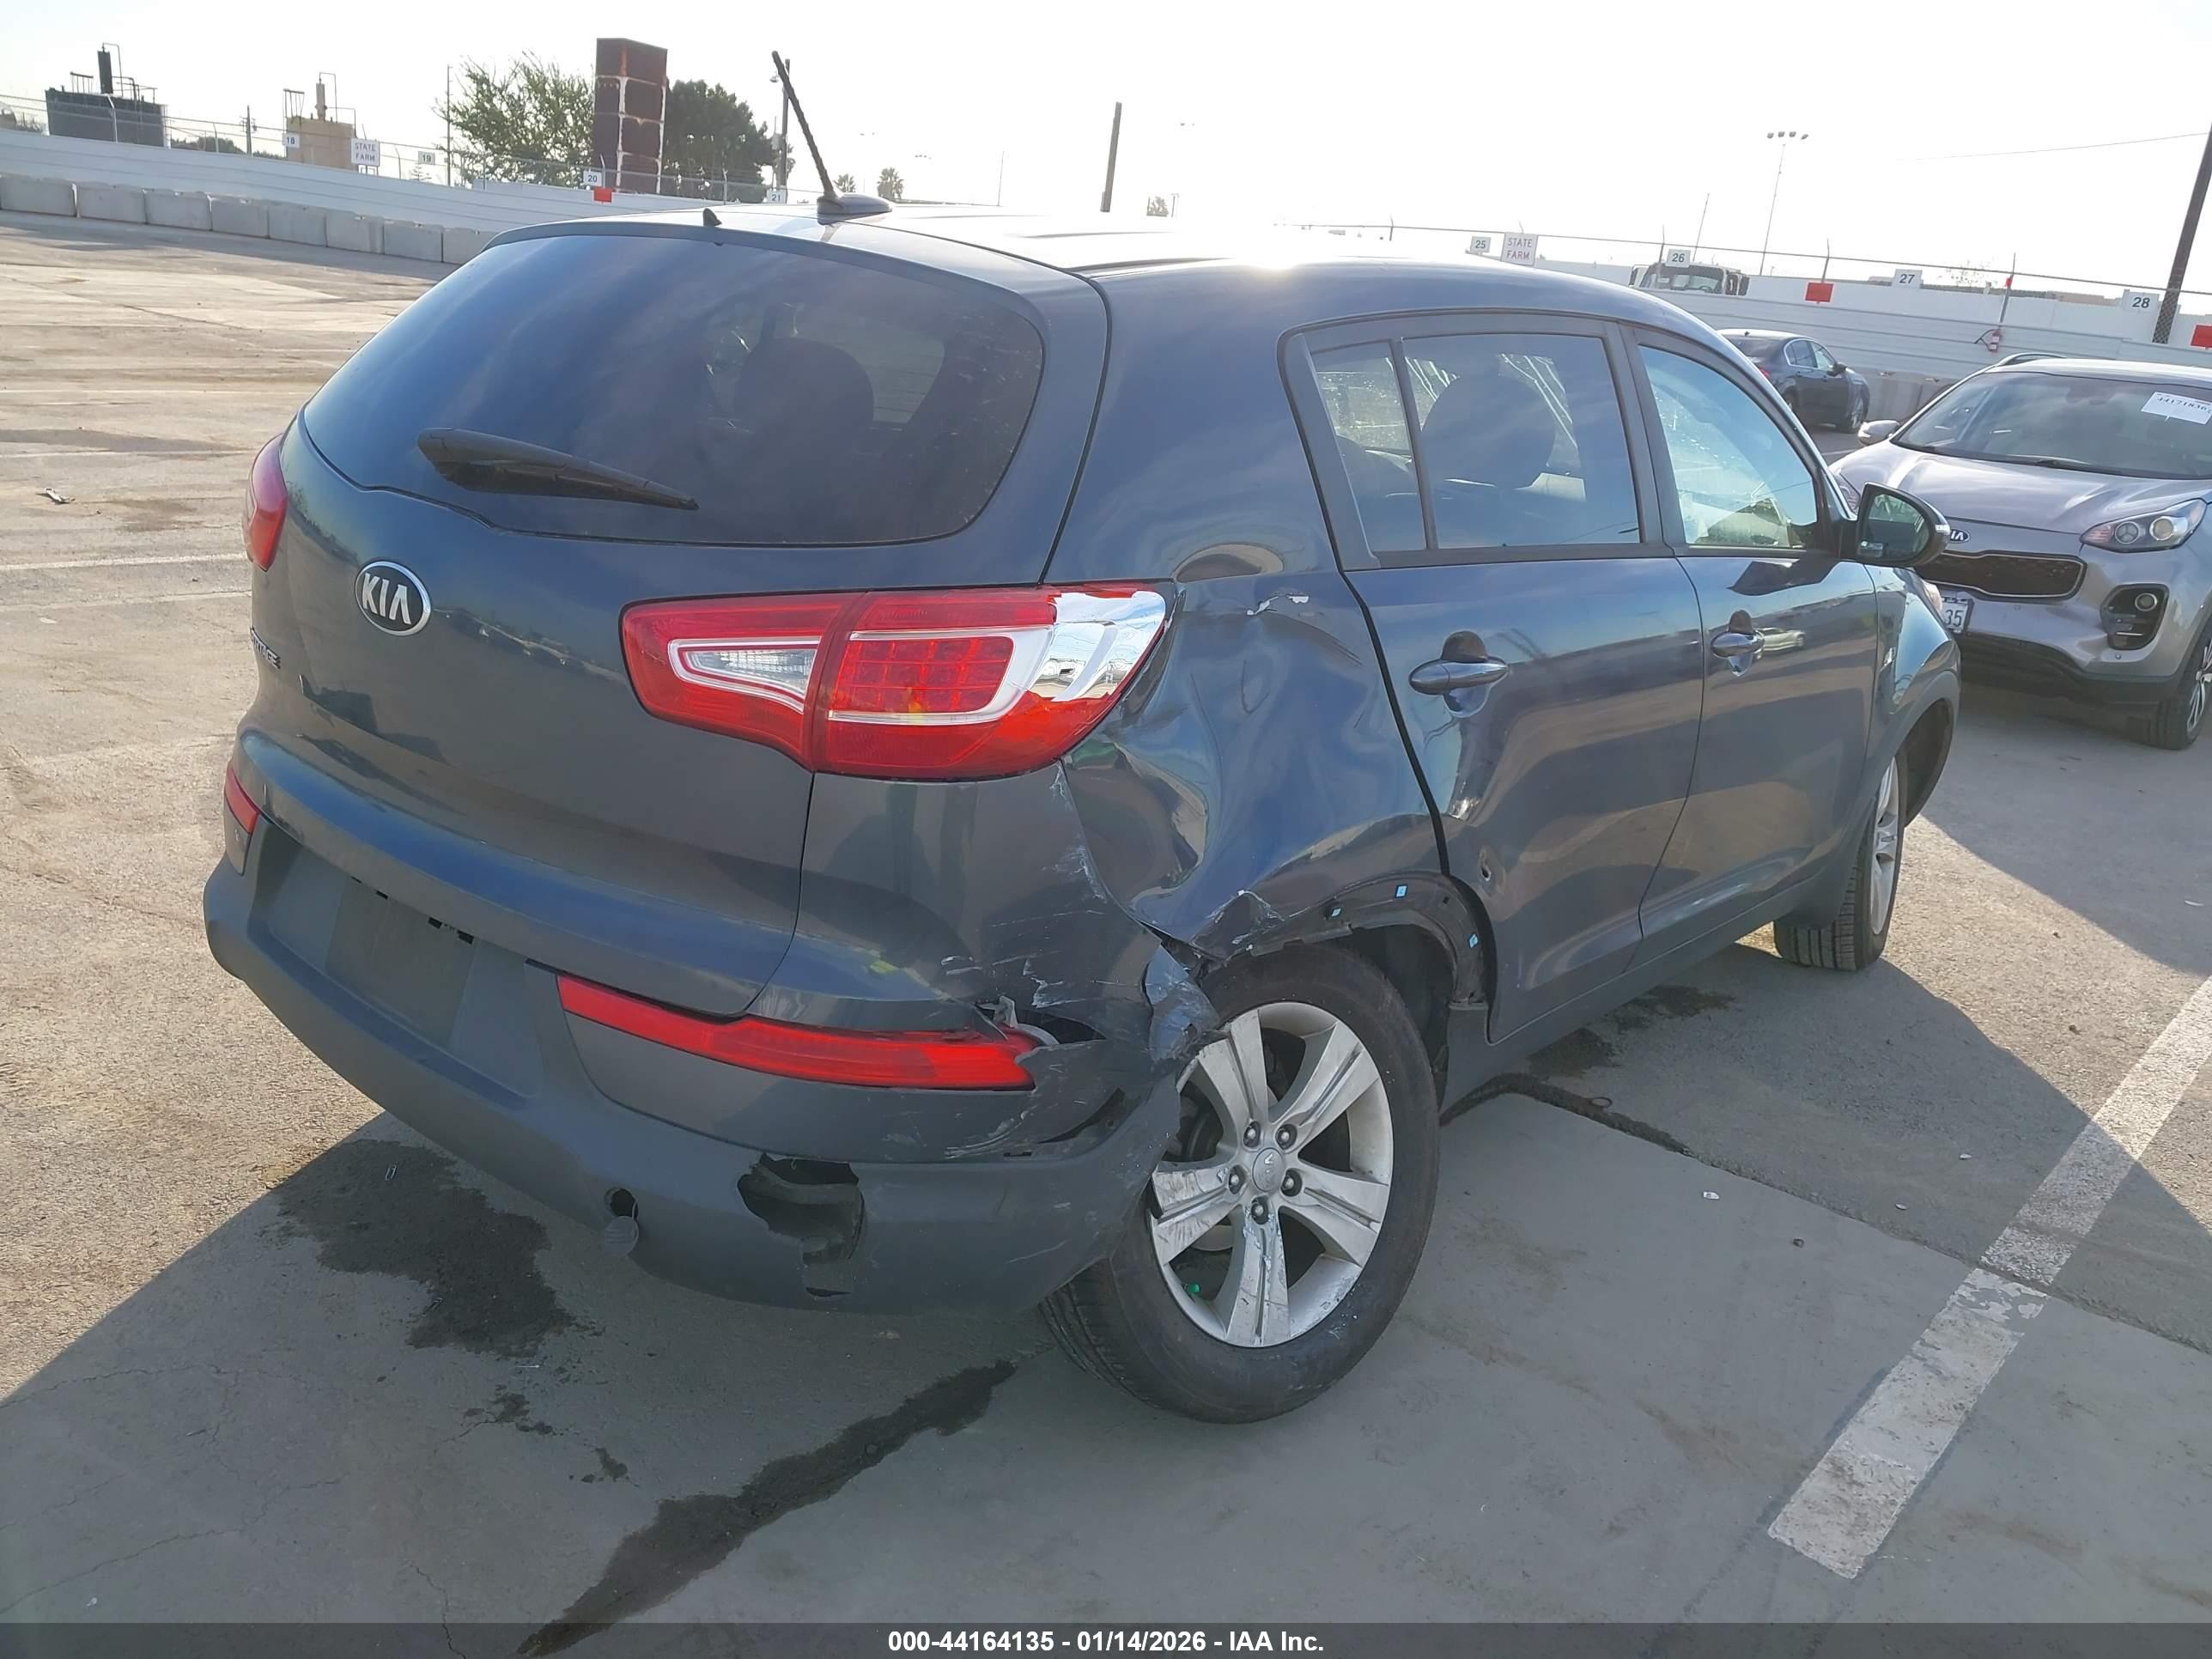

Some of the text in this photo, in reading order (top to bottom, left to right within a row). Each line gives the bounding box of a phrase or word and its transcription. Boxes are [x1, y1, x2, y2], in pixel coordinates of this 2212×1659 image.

[355, 143, 376, 151] STATE
[587, 174, 598, 183] 20
[1475, 240, 1486, 249] 25
[1507, 237, 1532, 248] STATE
[1506, 250, 1530, 260] FARM
[1672, 252, 1686, 263] 26
[1899, 273, 1916, 283] 27
[2131, 296, 2151, 309] 28
[362, 572, 412, 625] KIA
